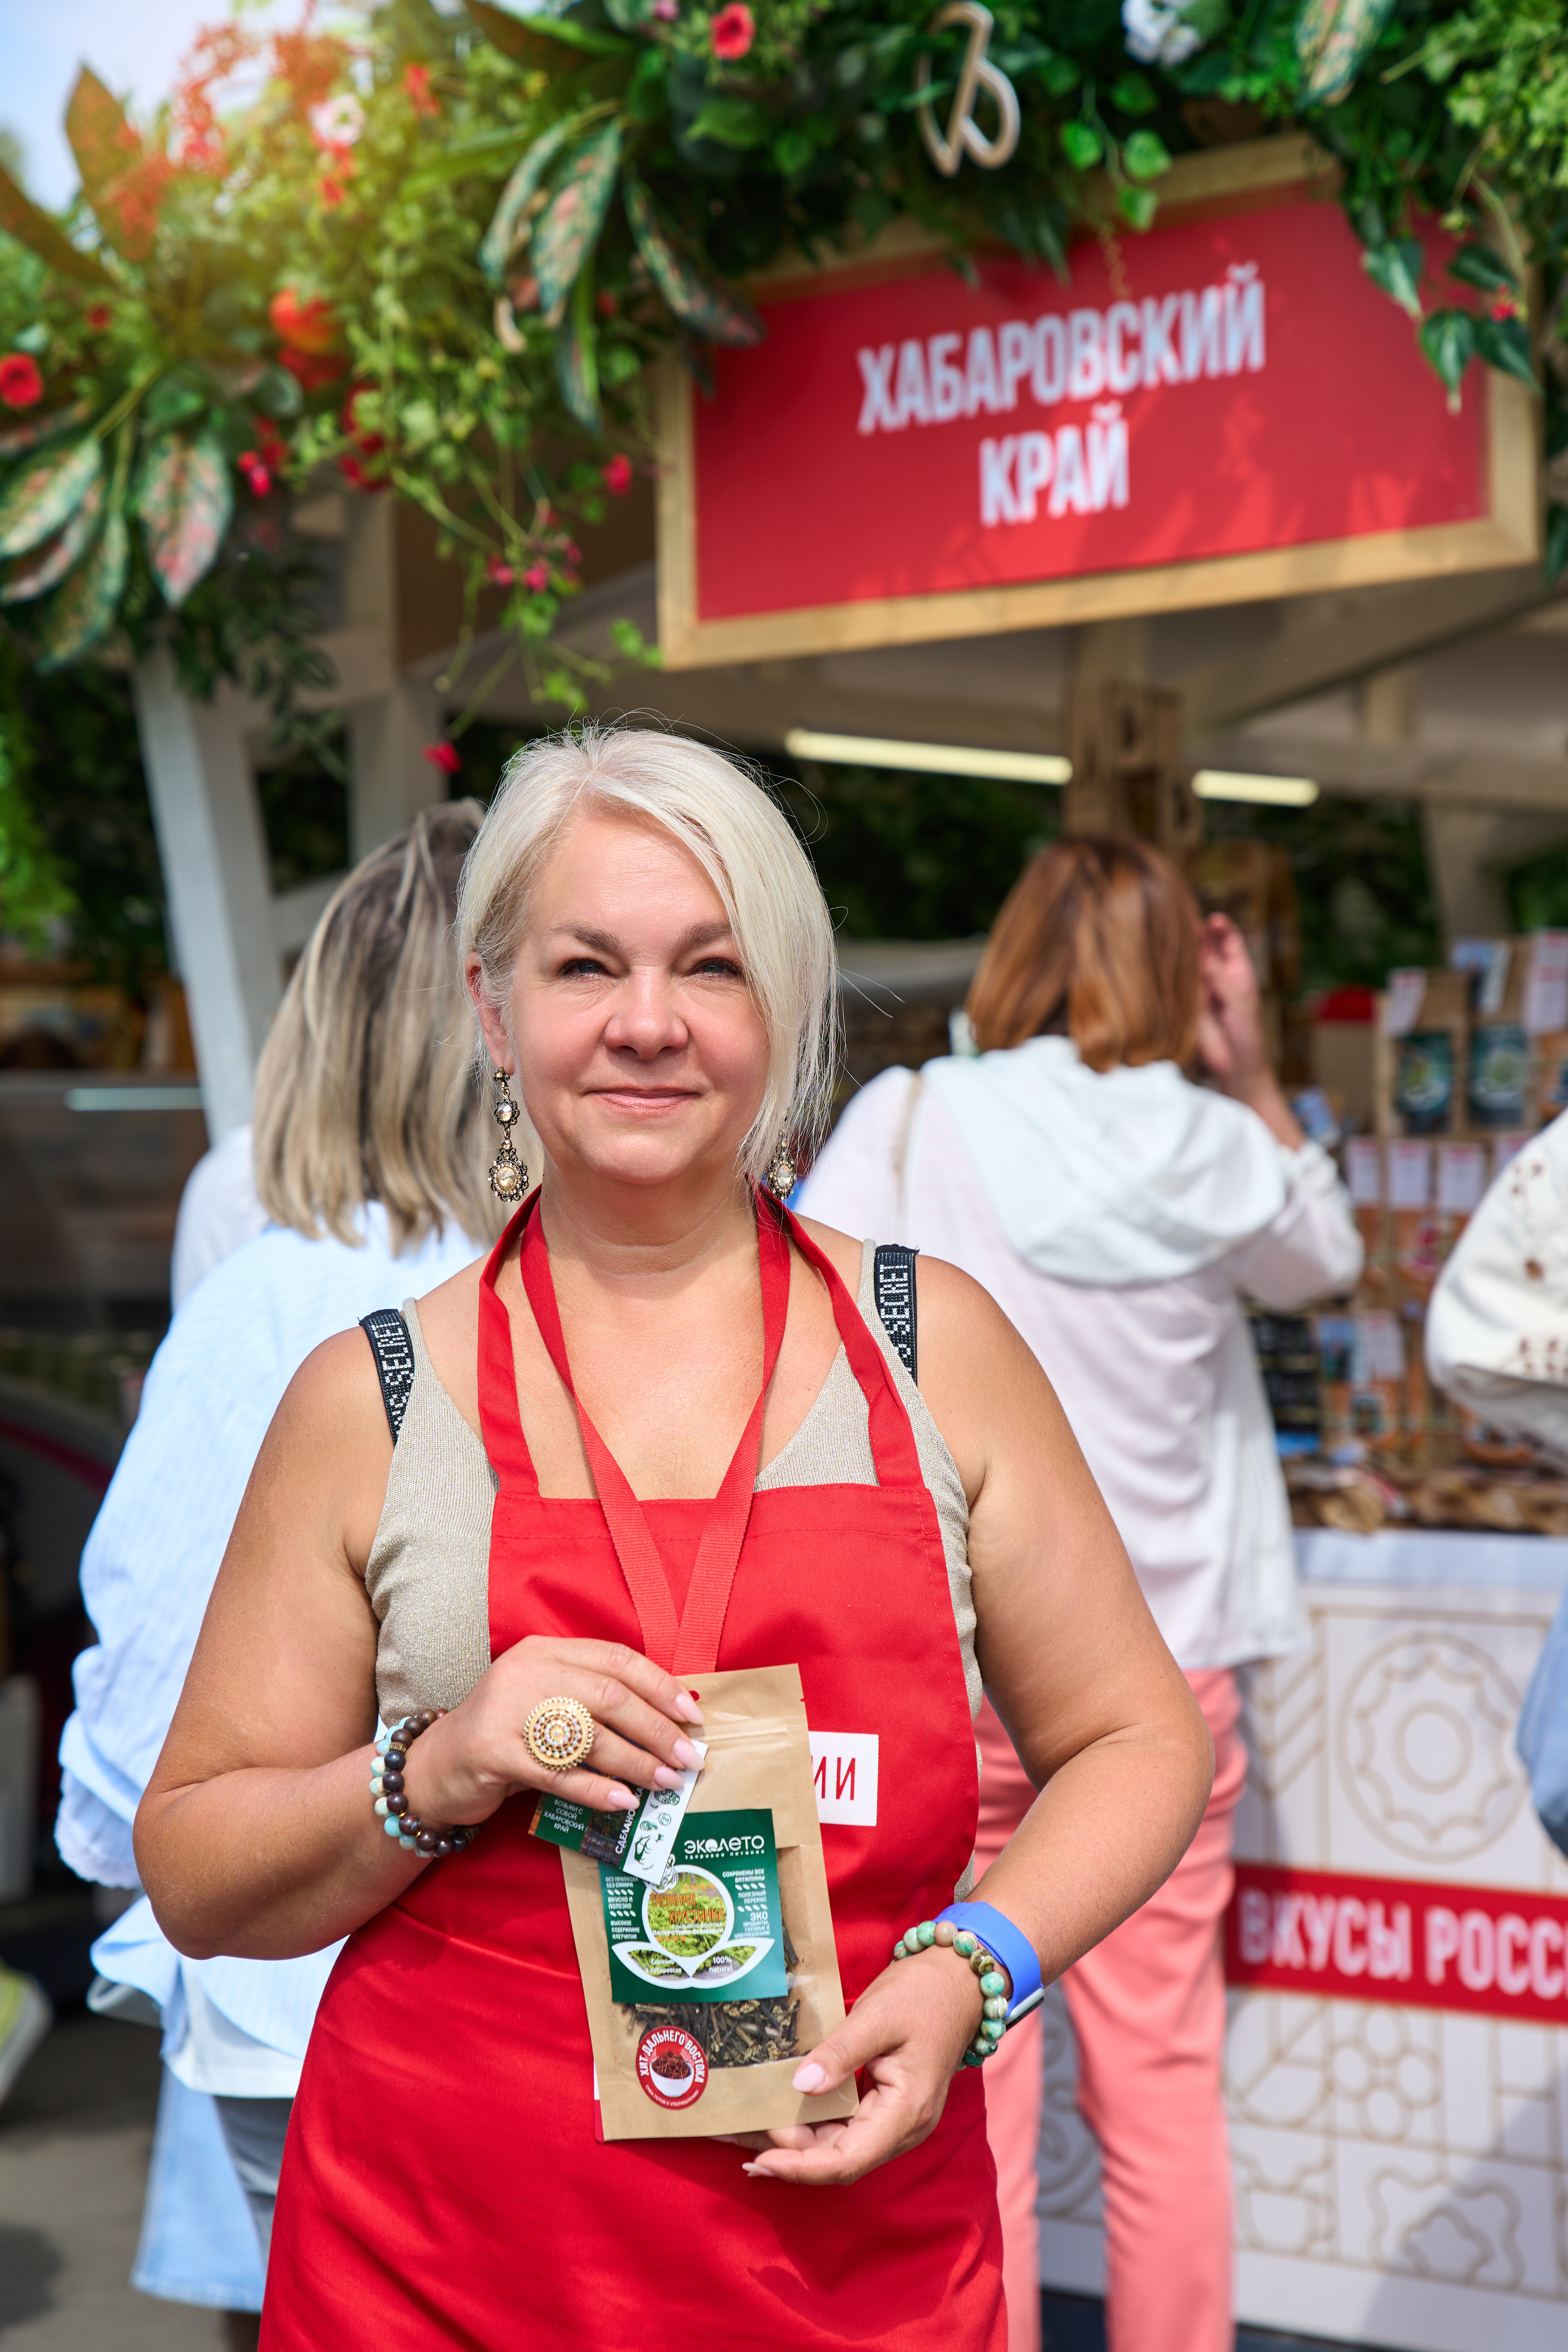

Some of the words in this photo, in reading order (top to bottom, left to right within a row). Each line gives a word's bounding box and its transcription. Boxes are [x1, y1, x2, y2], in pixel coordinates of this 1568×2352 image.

[857, 260, 1266, 436] ХАБАРОВСКИЙ
[980, 399, 1130, 527] КРАЙ
[879, 1264, 910, 1334] SECRET
[371, 1322, 414, 1385] SECRET
[554, 1799, 578, 1813] ВОЗЬМИ
[556, 1807, 577, 1820] СОБОЙ
[543, 1811, 585, 1831] ХАБАРОВСКИЙ
[554, 1822, 569, 1833] КРАЙ
[615, 1809, 635, 1854] СДЕЛАНО
[722, 1869, 754, 1878] СОХРАНЕНЫ
[735, 1875, 765, 1883] ВИТАМИНЫ
[738, 1889, 766, 1899] ПОЛЕЗНЫЙ
[668, 1908, 726, 1924] ХРУСТИНКА
[750, 1910, 768, 1922] ЭКО
[1239, 1886, 1412, 1982] ВКУСЫ
[1424, 1903, 1568, 2001] РОСС
[713, 1956, 732, 1964] 100%
[642, 2030, 685, 2057] ДАЛЬНЕГО
[639, 2055, 649, 2076] ХИТ
[685, 2039, 705, 2083] ВОСТОКА
[653, 2094, 666, 2105] ГОТОВ
